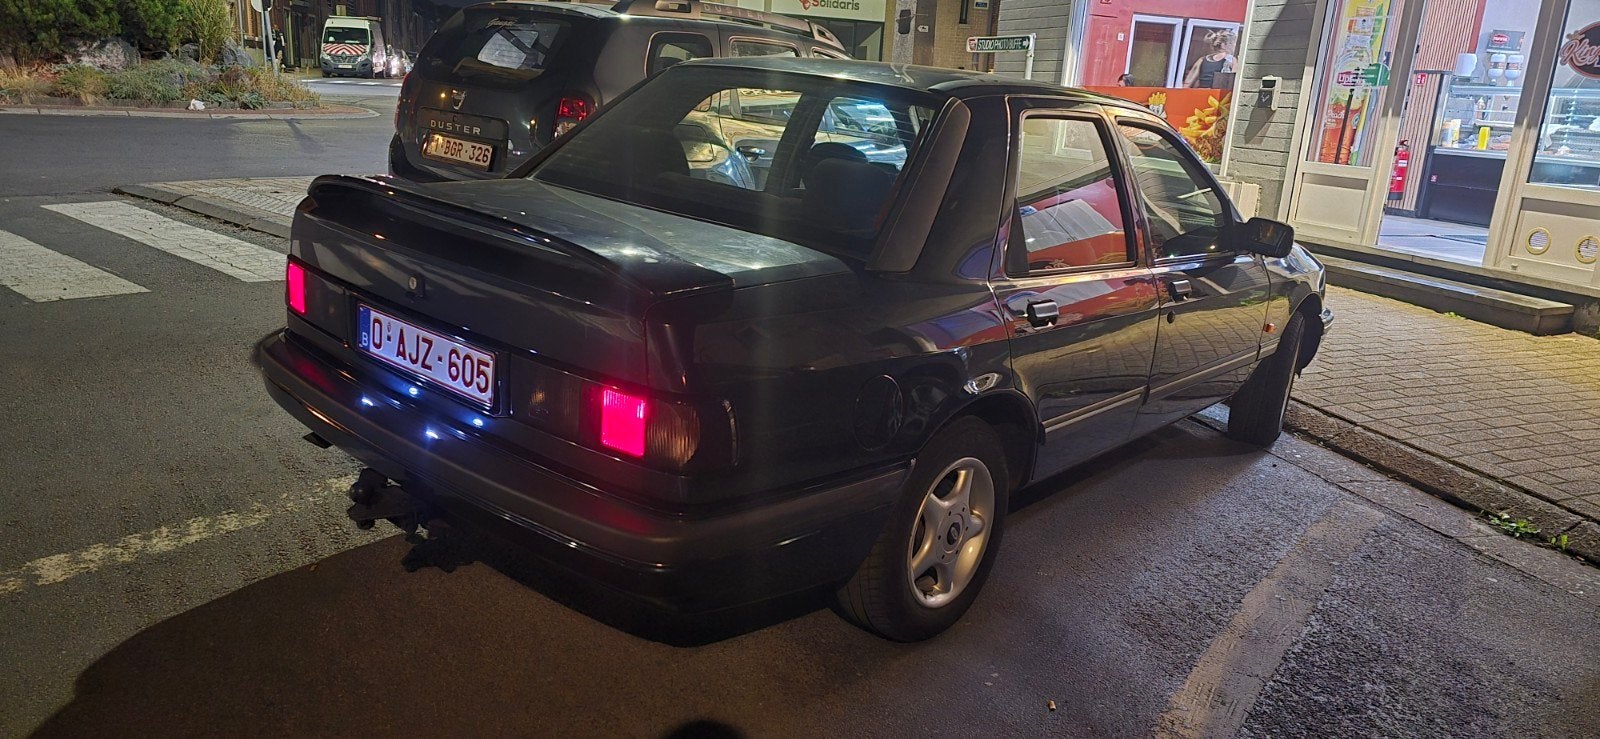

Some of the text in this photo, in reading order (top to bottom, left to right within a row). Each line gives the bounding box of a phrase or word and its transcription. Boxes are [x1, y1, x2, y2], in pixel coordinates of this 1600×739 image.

[812, 0, 860, 10] Solidaris
[977, 39, 993, 50] STUDIO
[994, 39, 1008, 49] PHOTO
[430, 120, 481, 135] DUSTER
[361, 331, 368, 346] B
